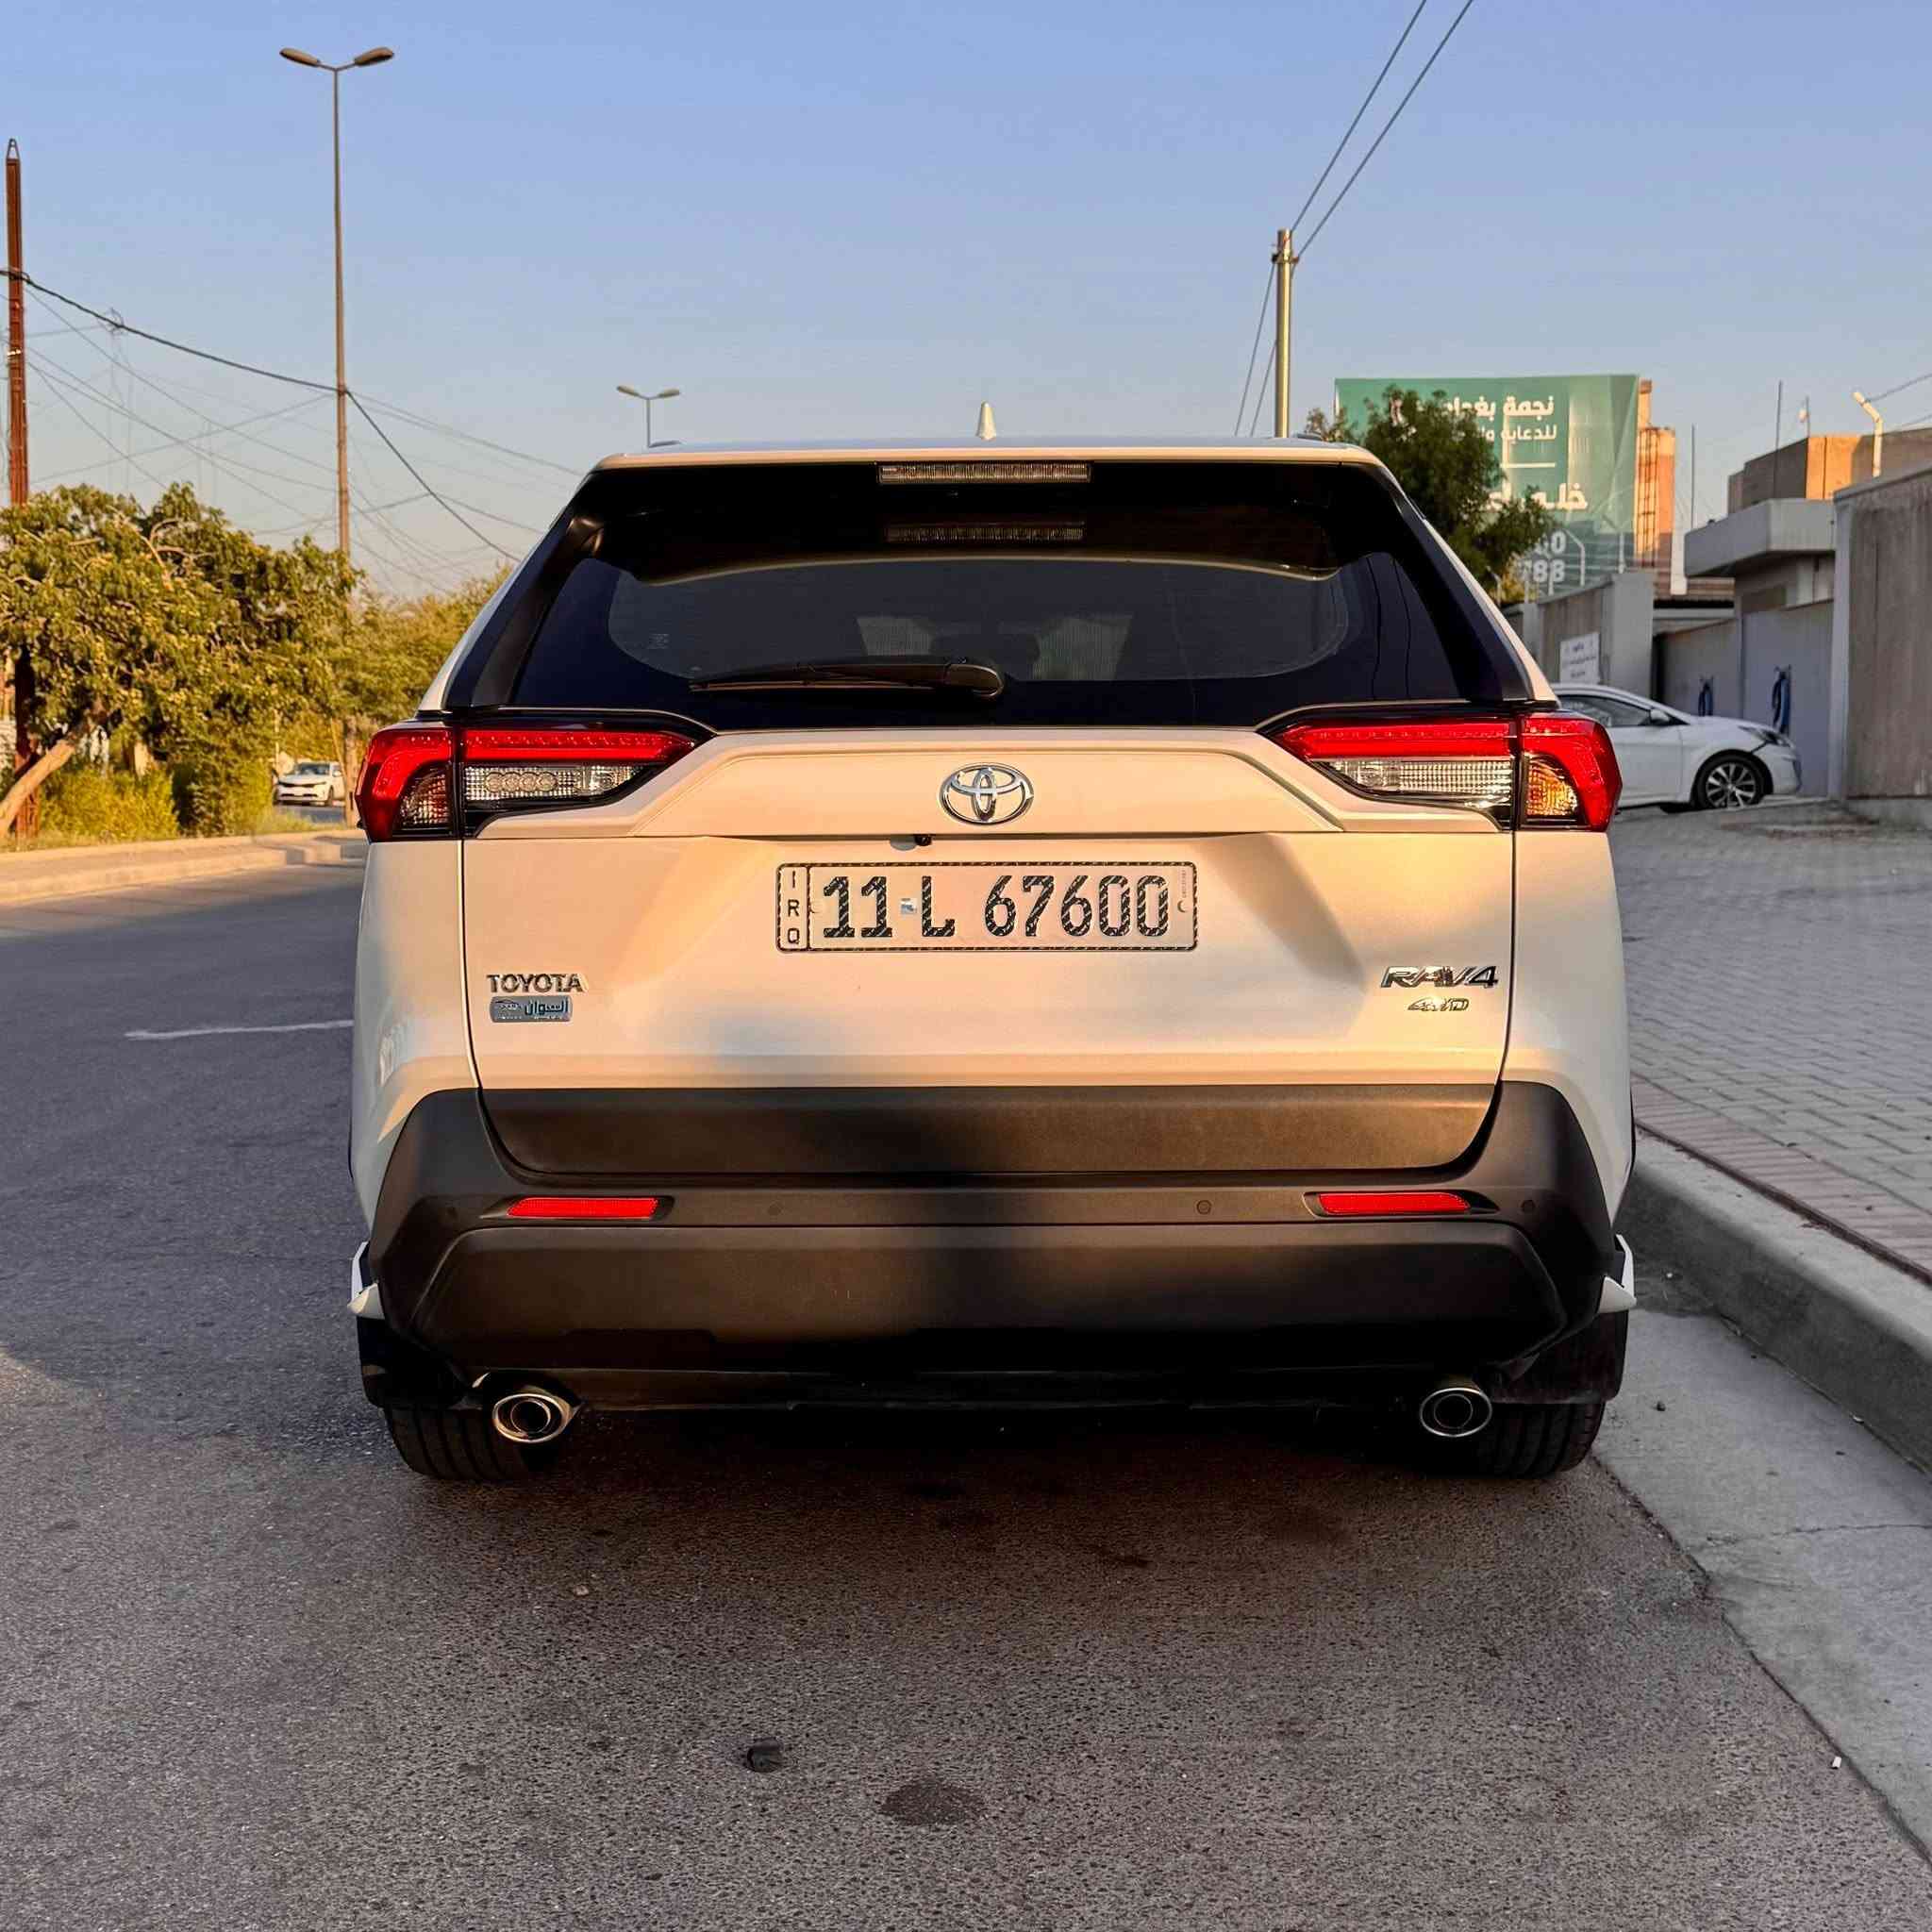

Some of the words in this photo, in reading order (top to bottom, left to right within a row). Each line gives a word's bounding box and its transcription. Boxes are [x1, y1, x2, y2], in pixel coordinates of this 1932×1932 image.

[1503, 394, 1555, 421] نجمة
[783, 870, 800, 944] IRQ
[823, 875, 893, 938] 11
[921, 875, 956, 938] L
[984, 874, 1170, 938] 67600
[486, 974, 584, 992] TOYOTA
[1381, 966, 1500, 989] RAV4
